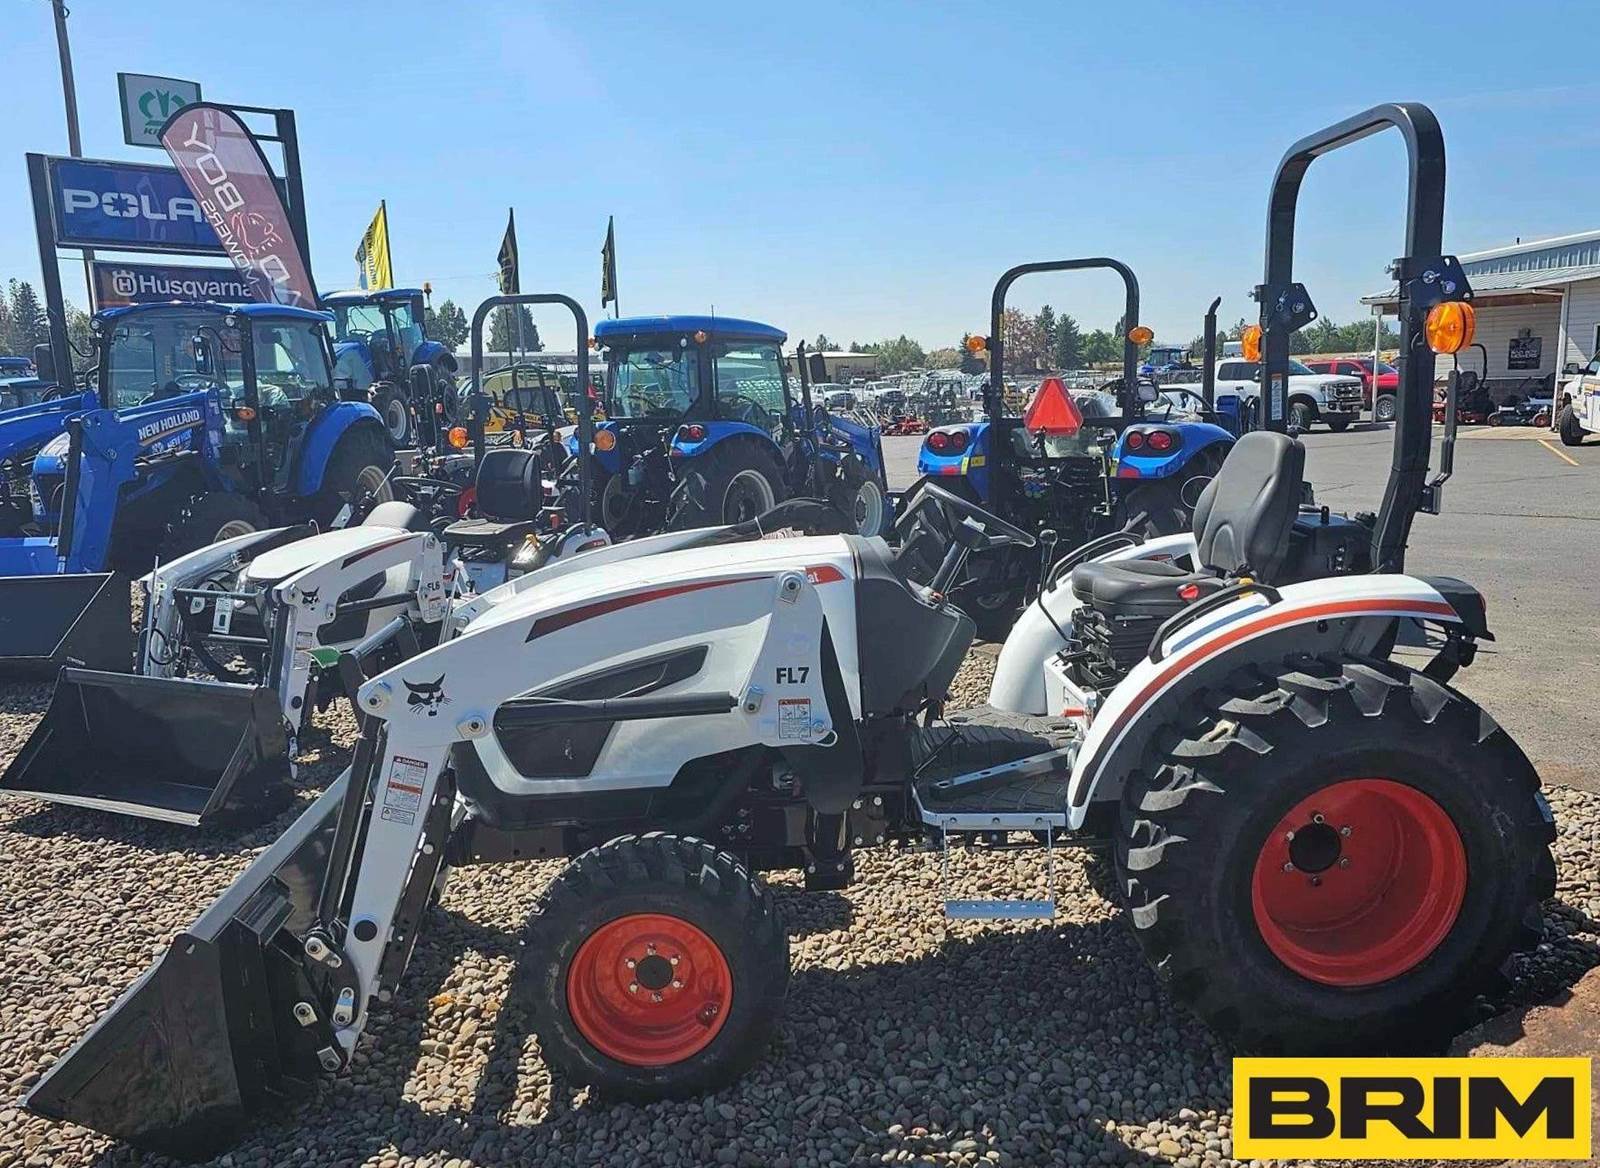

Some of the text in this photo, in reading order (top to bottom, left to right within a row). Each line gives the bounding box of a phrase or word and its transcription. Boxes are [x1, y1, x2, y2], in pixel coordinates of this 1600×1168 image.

[63, 188, 208, 223] POLA
[139, 274, 252, 298] Husqvarna
[138, 421, 161, 440] NEW
[160, 409, 201, 431] HOLLAND
[776, 666, 810, 685] FL7
